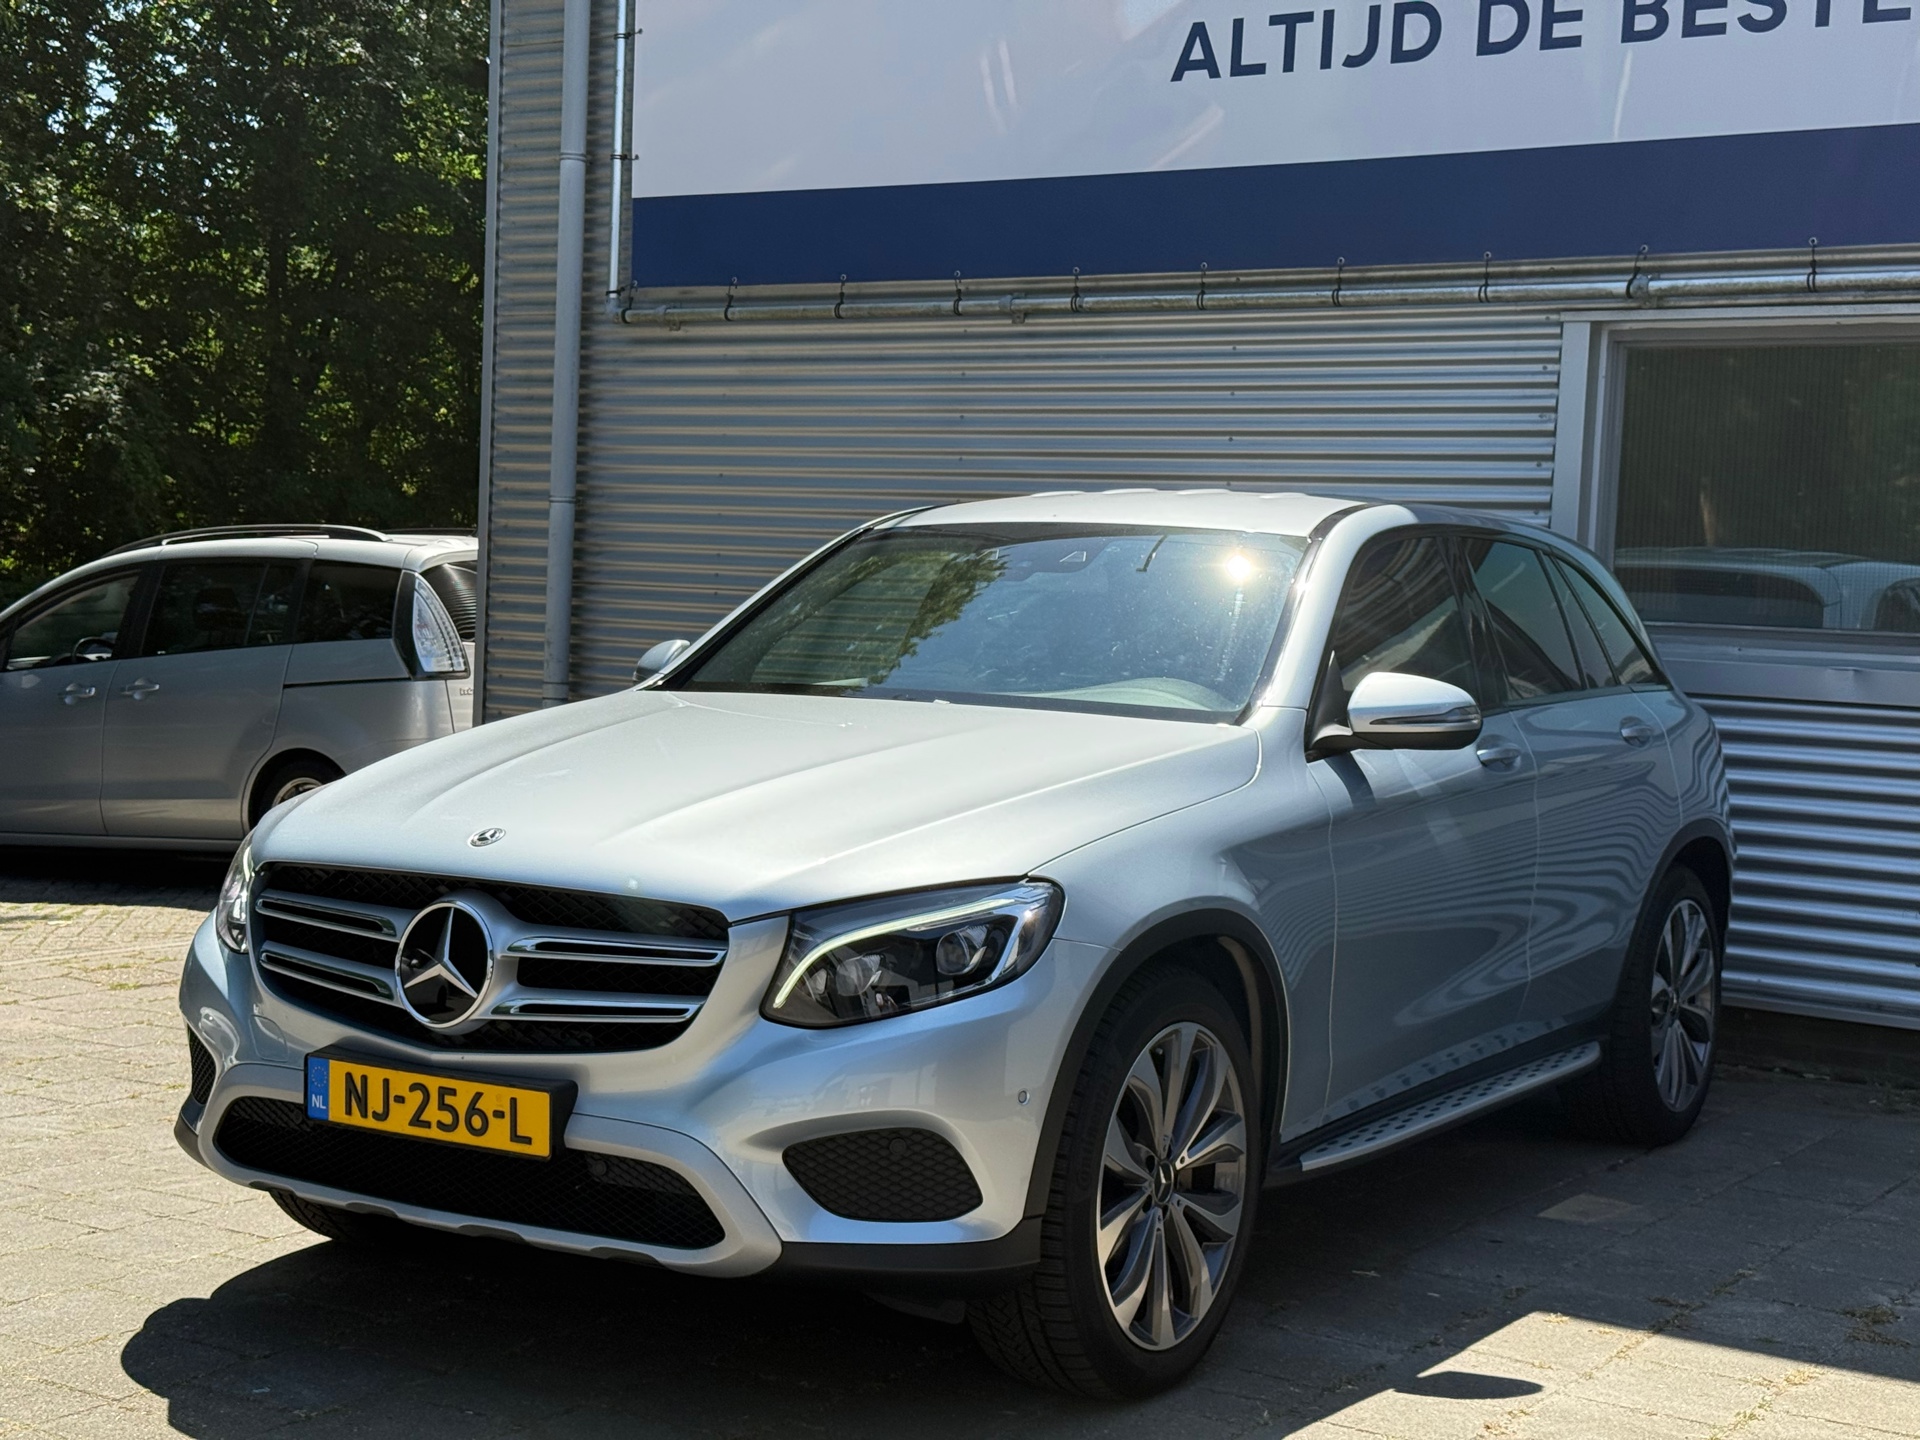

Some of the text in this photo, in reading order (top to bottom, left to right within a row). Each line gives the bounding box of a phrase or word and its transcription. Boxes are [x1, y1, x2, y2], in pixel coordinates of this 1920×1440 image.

[1170, 1, 1442, 82] ALTIJD
[1476, 0, 1583, 57] DE
[311, 1093, 327, 1110] NL
[344, 1071, 533, 1146] NJ-256-L
